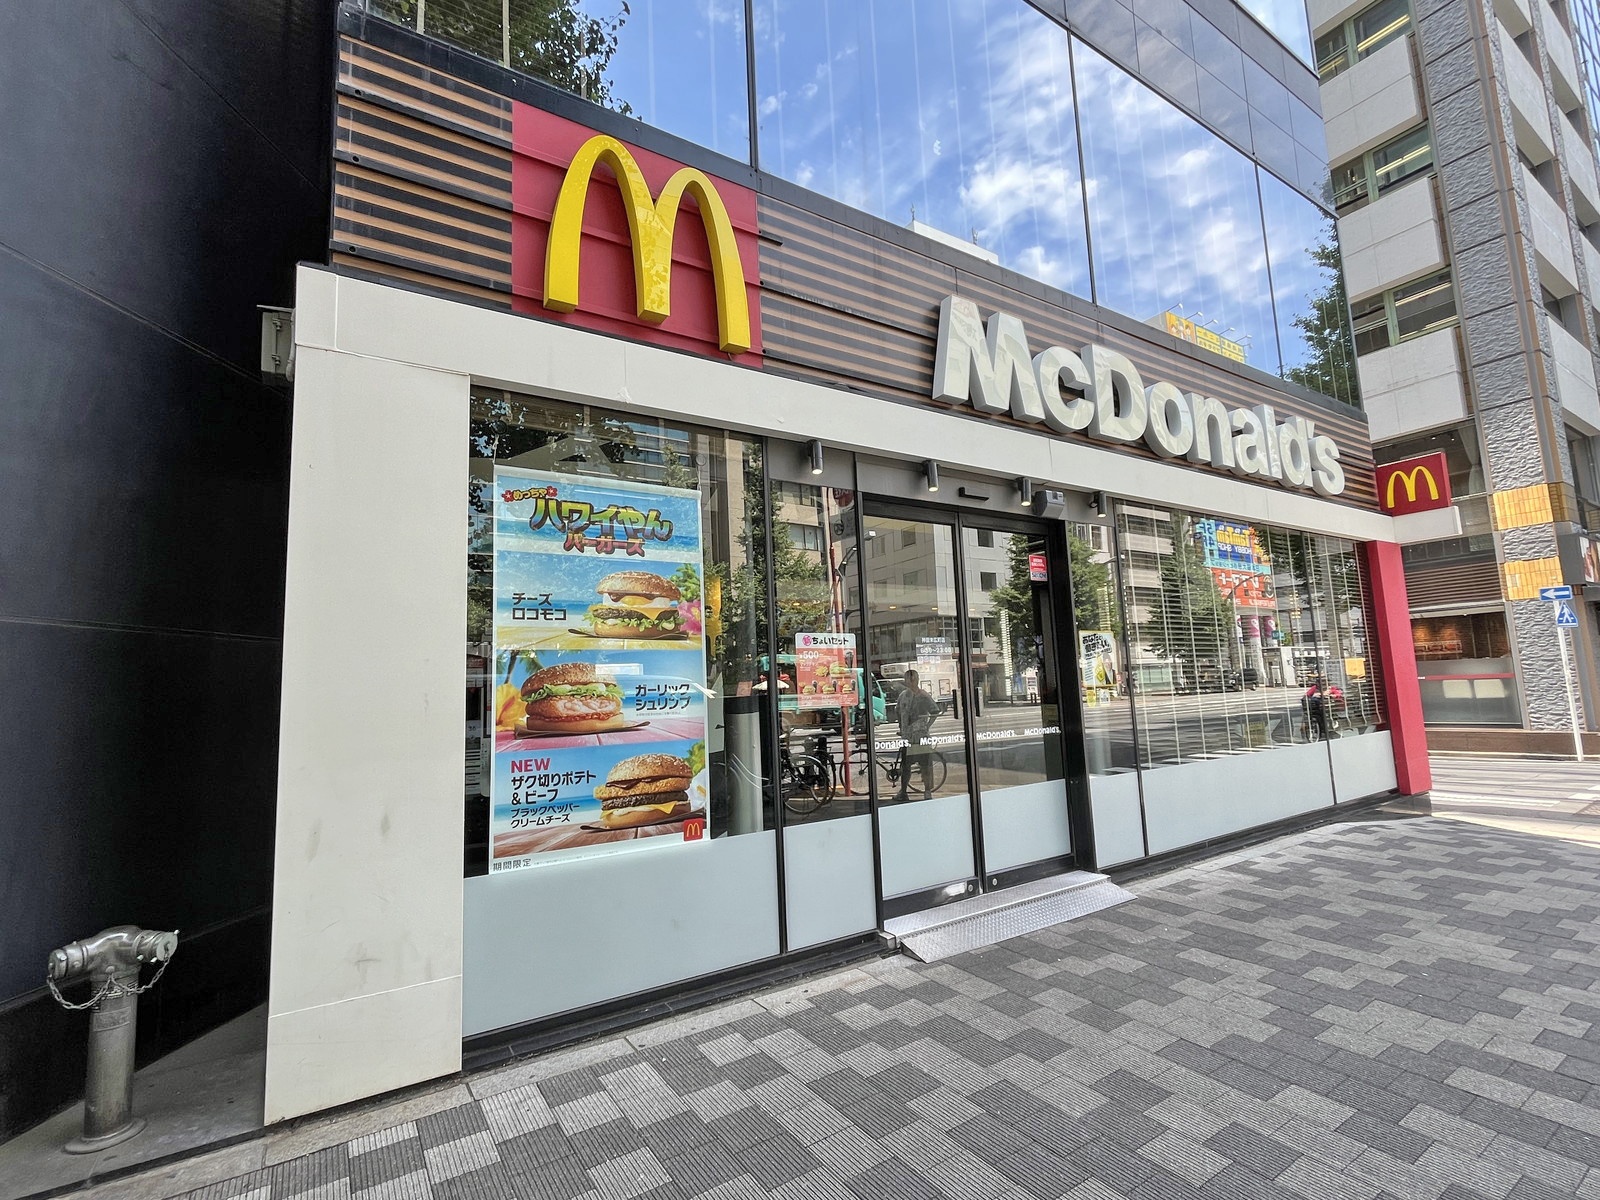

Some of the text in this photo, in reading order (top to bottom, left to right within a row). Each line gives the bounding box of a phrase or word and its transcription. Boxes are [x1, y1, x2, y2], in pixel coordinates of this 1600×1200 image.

[932, 293, 1345, 496] McDonald's
[513, 488, 547, 501] めっちゃ
[529, 499, 673, 542] ハワイやん
[563, 533, 645, 557] バーガーズ
[512, 593, 552, 606] チーズ
[512, 608, 567, 620] ロコモコ
[635, 684, 690, 697] ガーリック
[635, 696, 691, 711] シュリンプ
[511, 758, 551, 773] NEW
[511, 770, 597, 791] ザク切りポテト
[511, 789, 558, 805] & ビーフ
[511, 803, 580, 819] ブラックペッパー
[511, 813, 570, 829] クリームチーズ
[493, 858, 532, 871] 期間限定
